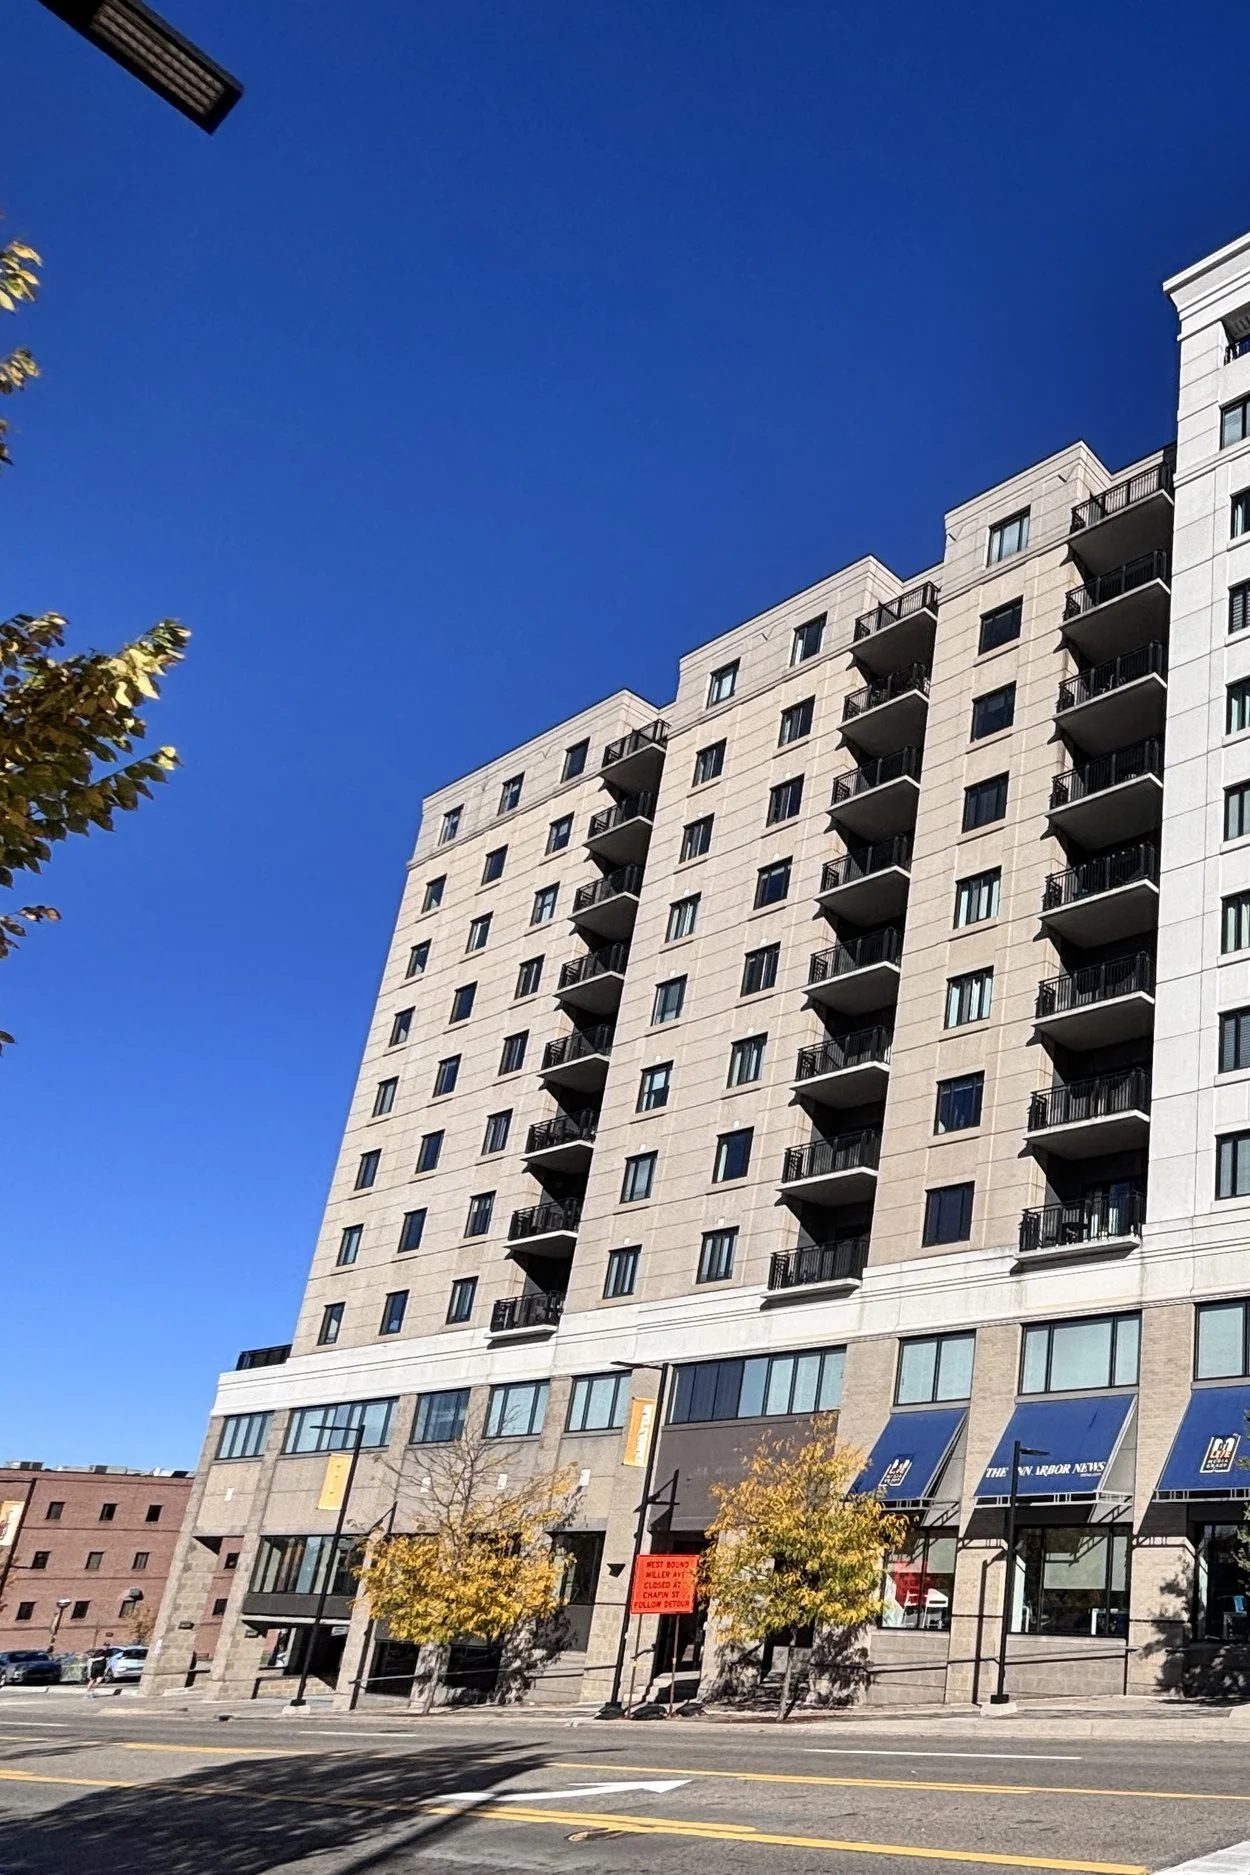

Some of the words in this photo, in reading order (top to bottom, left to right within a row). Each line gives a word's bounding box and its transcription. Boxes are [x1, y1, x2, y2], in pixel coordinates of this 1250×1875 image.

[985, 1467, 1009, 1478] THE
[1017, 1466, 1034, 1476] NN
[1035, 1463, 1072, 1477] ARBOR
[1072, 1461, 1107, 1474] NEWS
[666, 1561, 690, 1569] BOUND
[645, 1571, 671, 1579] MILLER
[643, 1581, 671, 1589] CLOSED
[642, 1591, 669, 1599] CHAPIN
[633, 1600, 662, 1609] FOLLOW
[664, 1600, 690, 1608] DETOUR
